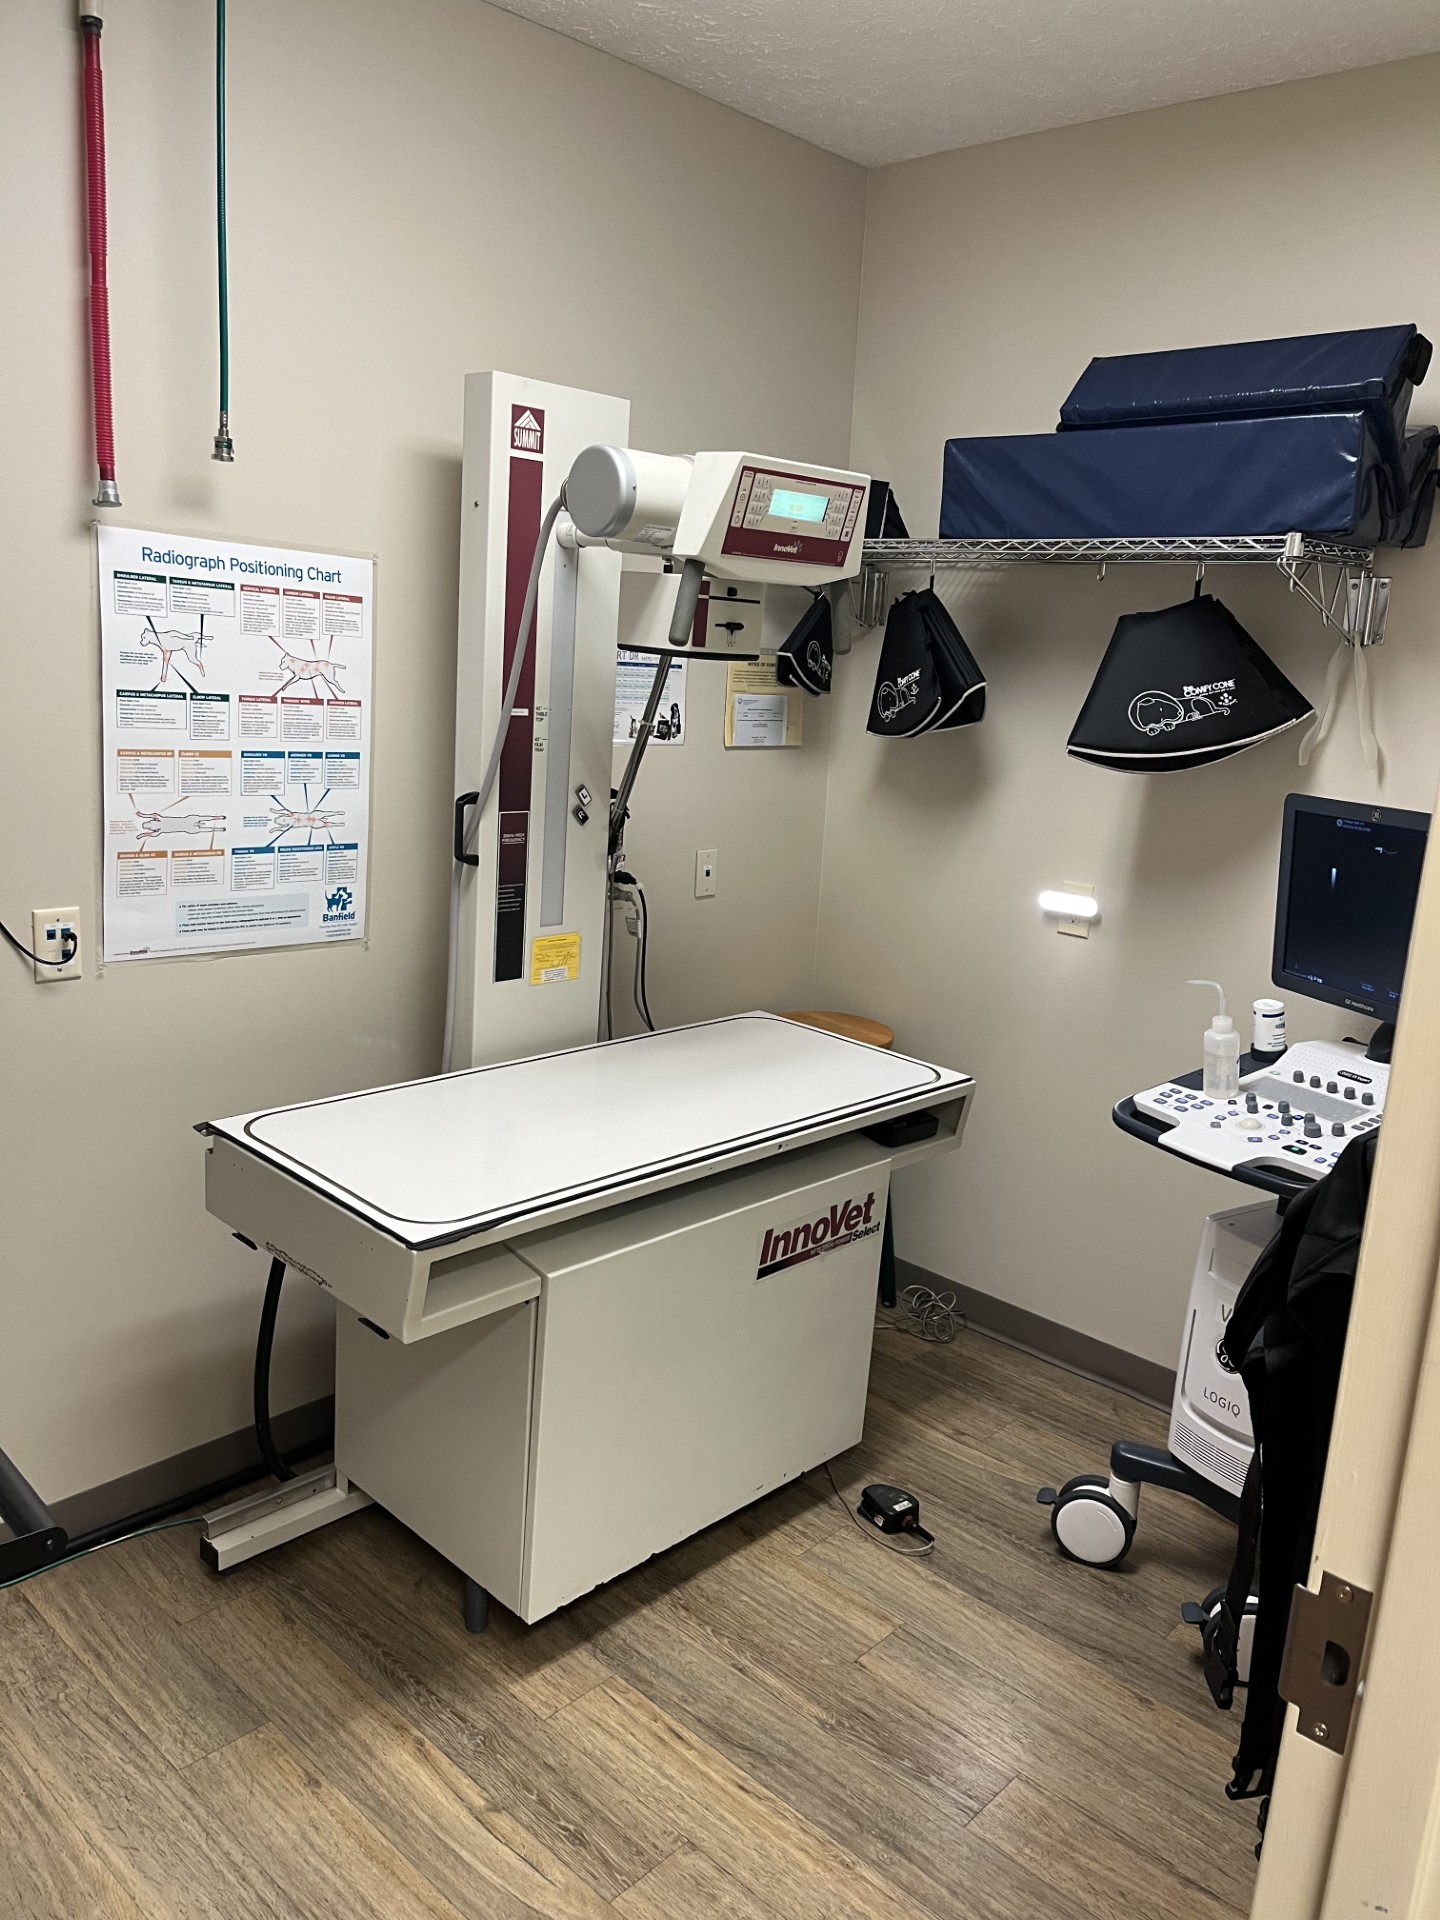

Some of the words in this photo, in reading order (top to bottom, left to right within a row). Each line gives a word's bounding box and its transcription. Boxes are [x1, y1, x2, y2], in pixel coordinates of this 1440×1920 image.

[513, 427, 541, 451] SUMMIT
[773, 543, 798, 554] InnoVet
[141, 546, 226, 572] Radiograph
[230, 557, 303, 582] Positioning
[308, 566, 342, 583] Chart
[629, 651, 639, 660] DR
[1184, 683, 1212, 697] COMFY
[1212, 678, 1236, 690] CONE
[578, 810, 585, 819] R
[322, 911, 356, 922] Banfield
[1351, 1001, 1374, 1012] Healthcare
[759, 1191, 876, 1266] InnoVet
[852, 1221, 881, 1241] Select
[1203, 1386, 1241, 1419] LOGIQ
